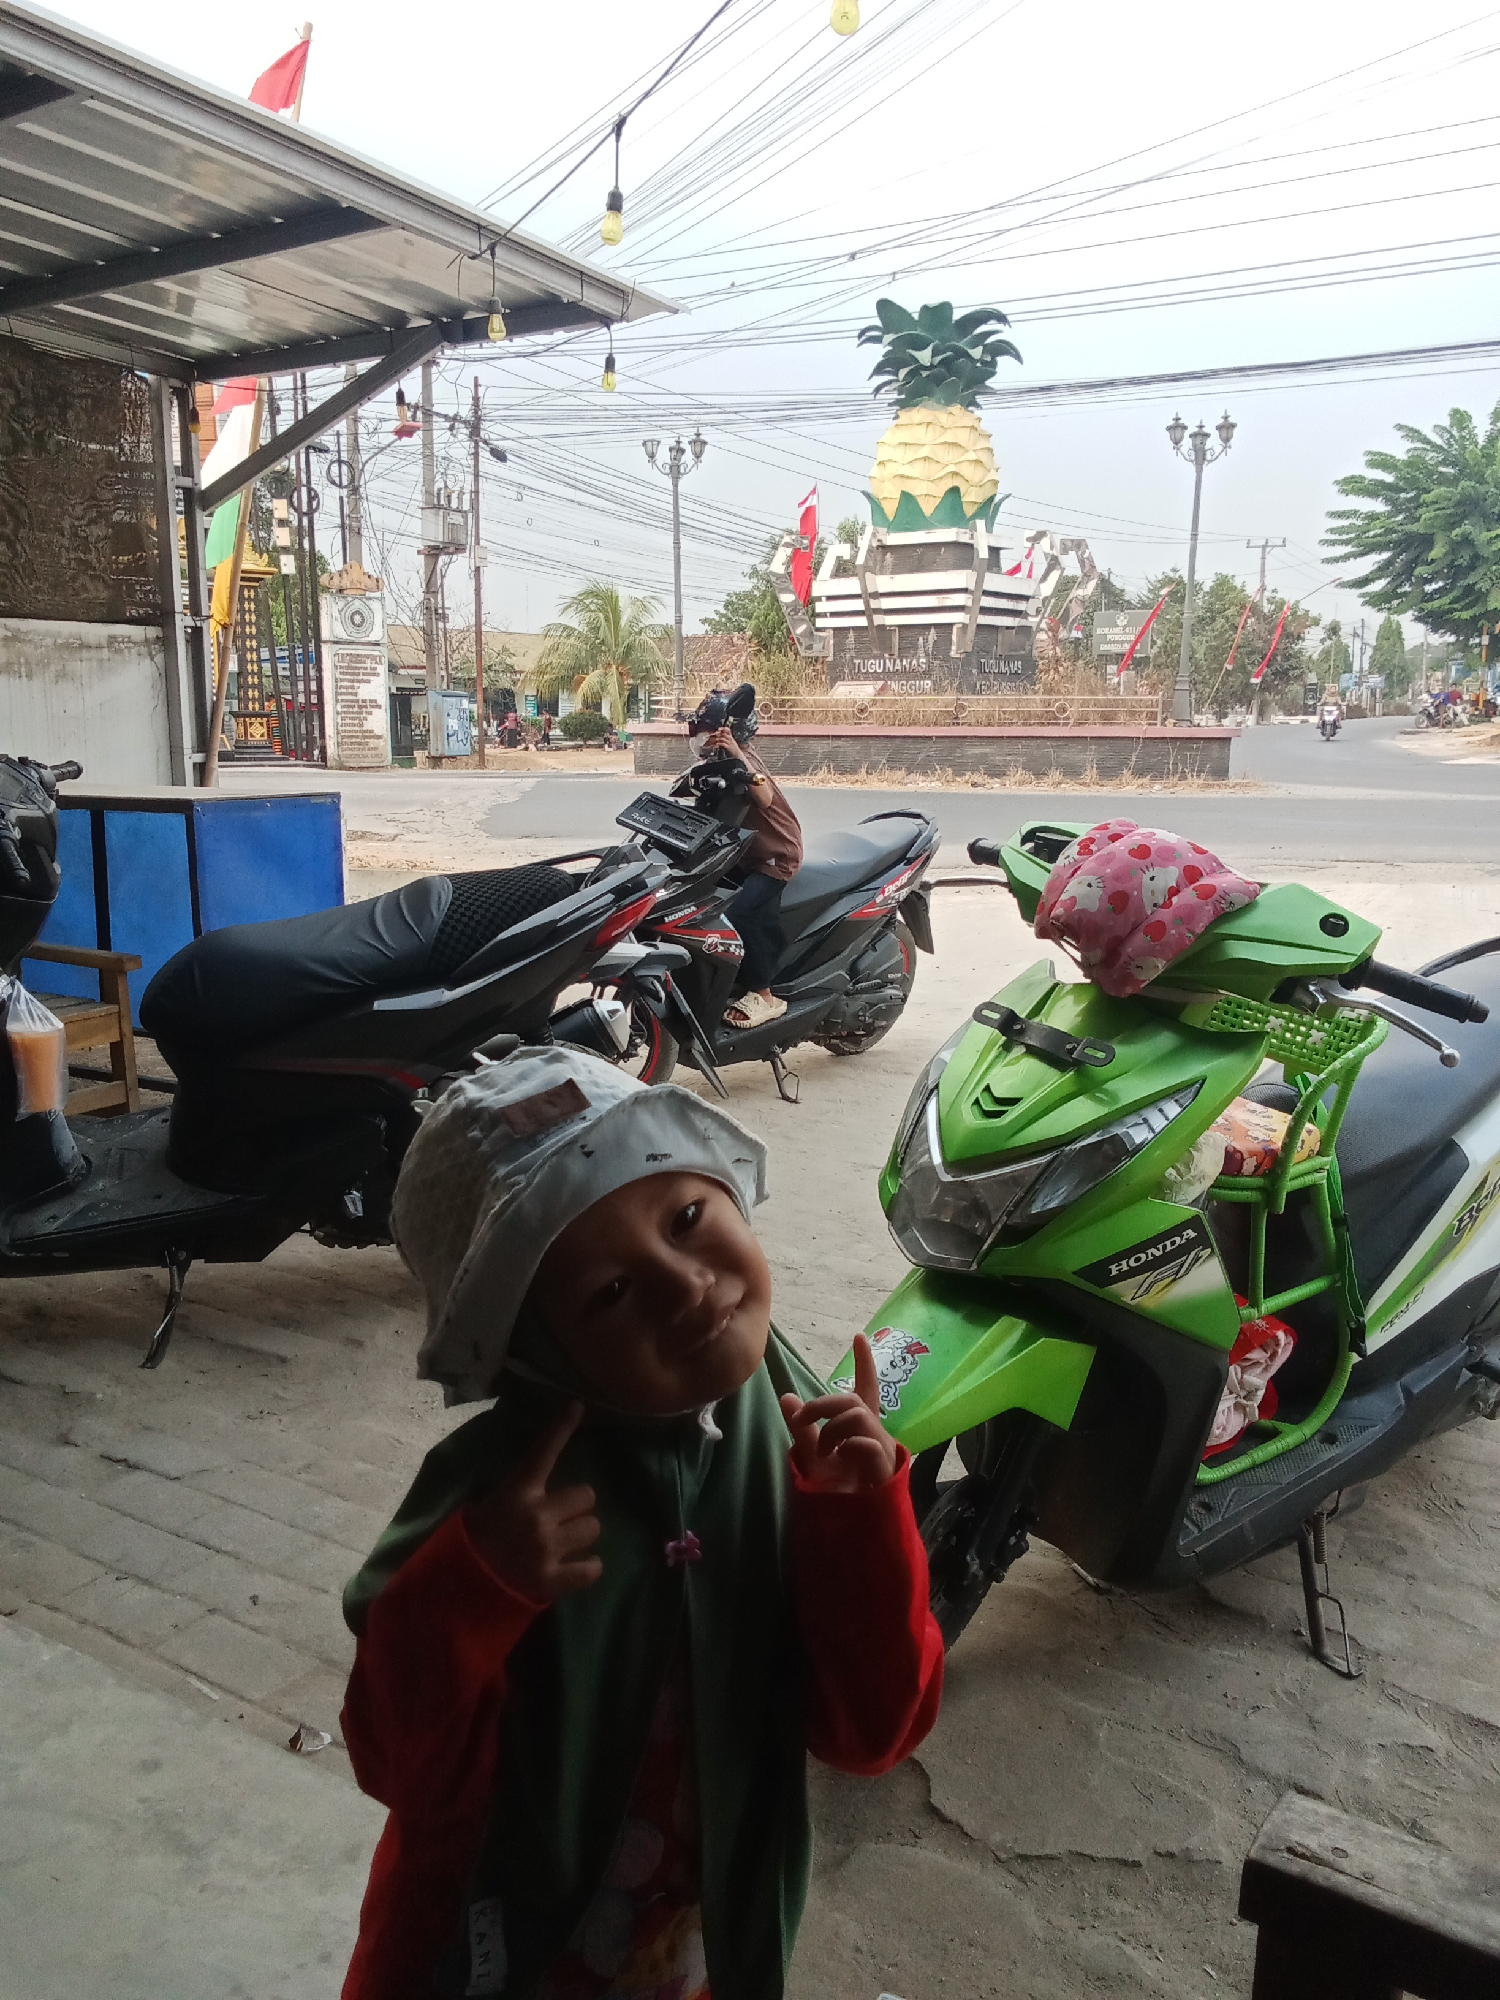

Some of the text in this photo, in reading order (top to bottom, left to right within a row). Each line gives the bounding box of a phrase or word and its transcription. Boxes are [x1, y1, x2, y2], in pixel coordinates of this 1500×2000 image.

[854, 658, 927, 673] TUGU NANAS
[980, 659, 999, 673] TUGU
[663, 905, 698, 923] HONDA
[1108, 1228, 1198, 1277] HONDA
